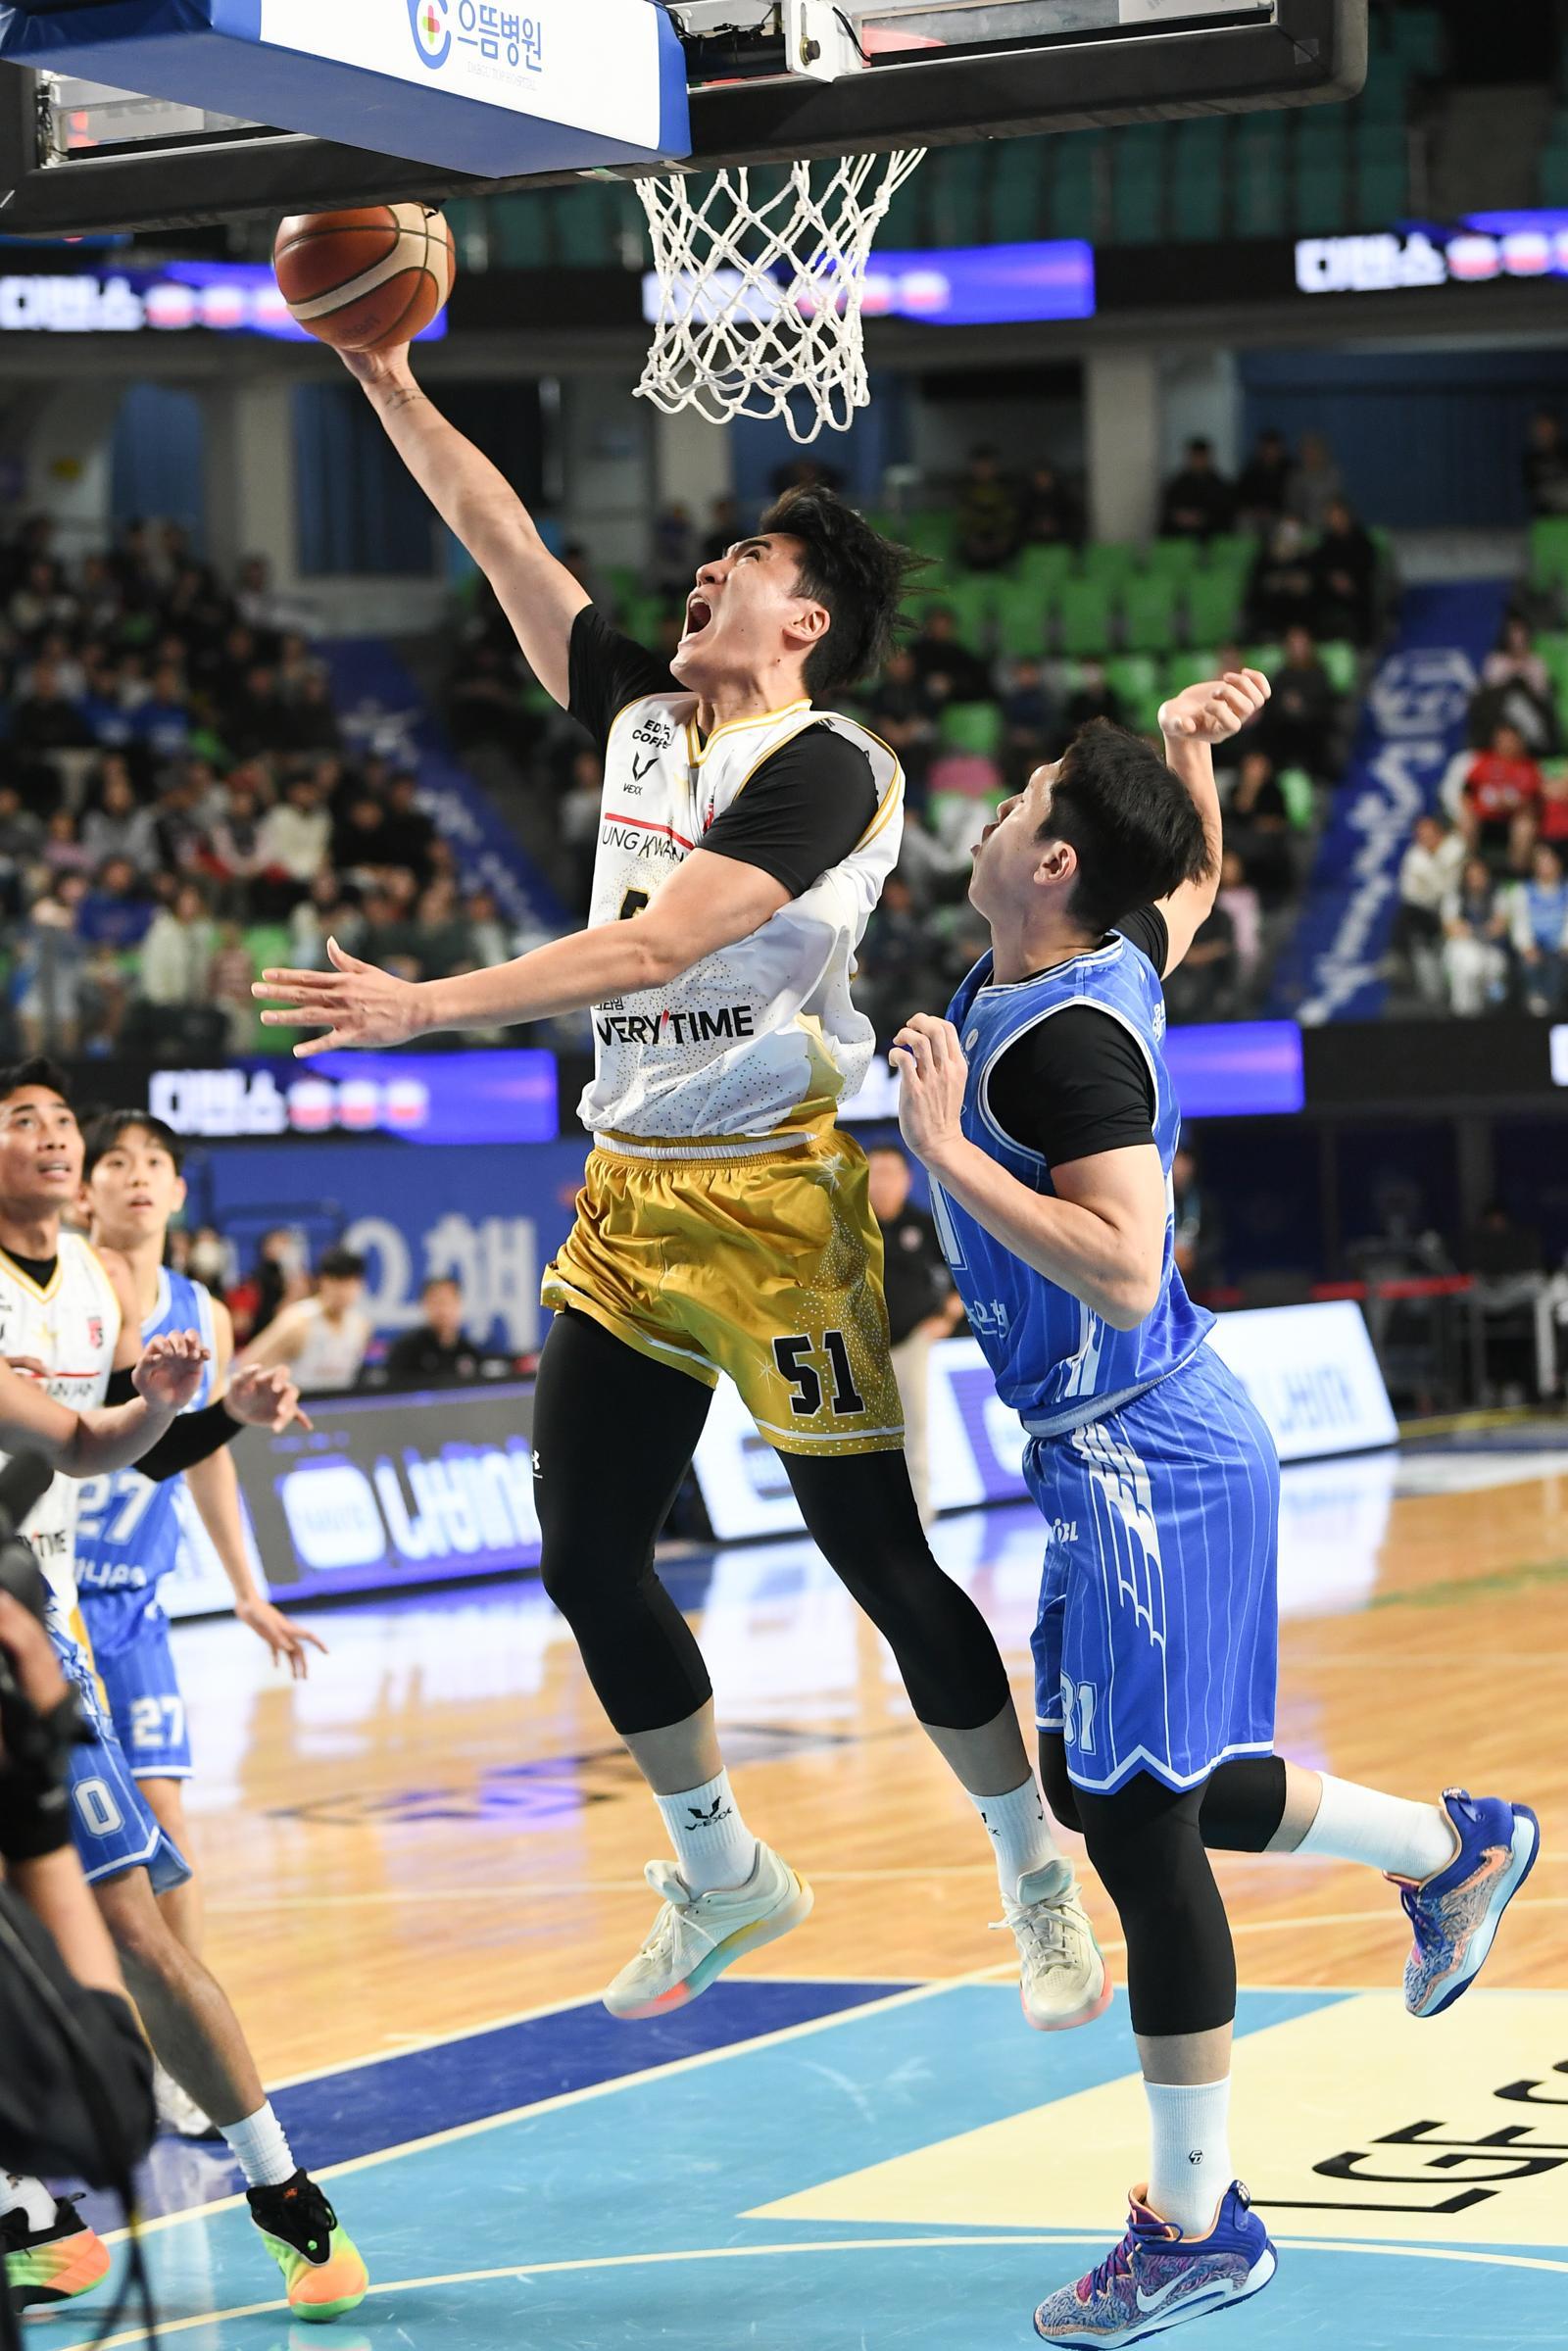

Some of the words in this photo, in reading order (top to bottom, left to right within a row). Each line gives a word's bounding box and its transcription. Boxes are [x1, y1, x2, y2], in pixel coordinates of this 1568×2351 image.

[457, 0, 542, 73] 으뜸병원
[602, 824, 640, 851] UNG
[596, 1004, 755, 1047] VERYTIME
[771, 1329, 866, 1418] 51
[75, 1471, 158, 1546] 27
[130, 1695, 185, 1748] 27
